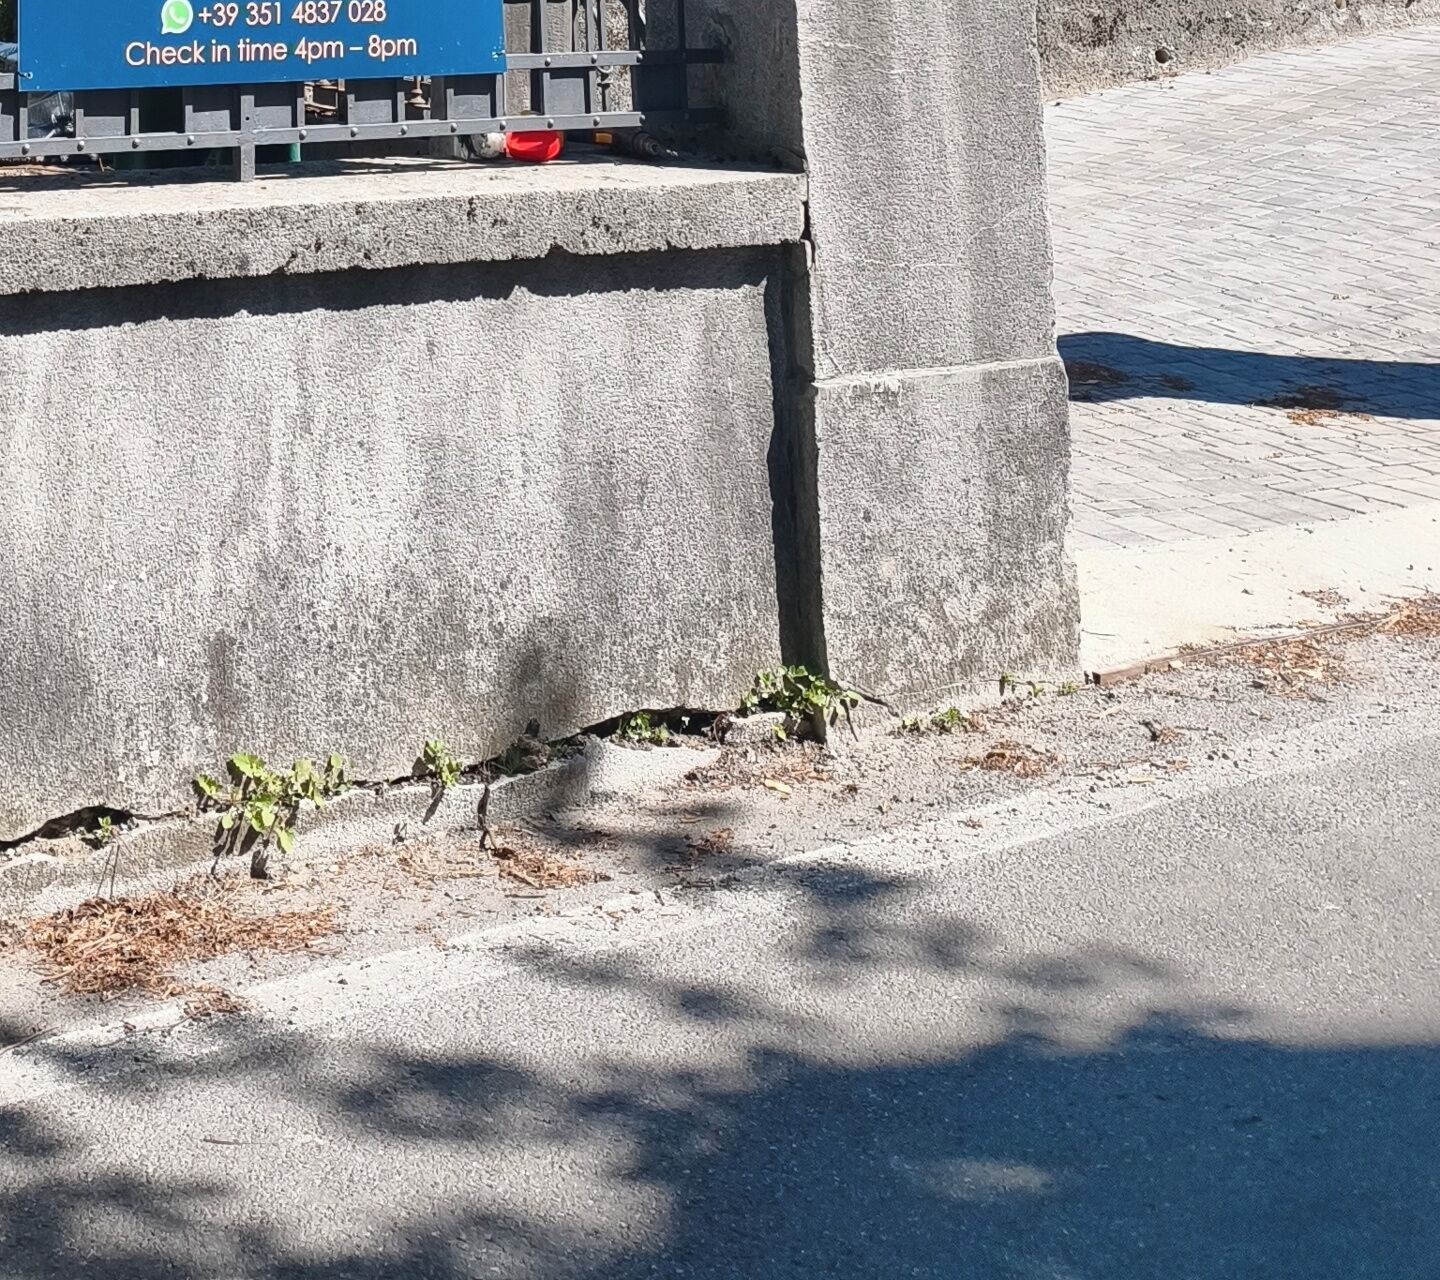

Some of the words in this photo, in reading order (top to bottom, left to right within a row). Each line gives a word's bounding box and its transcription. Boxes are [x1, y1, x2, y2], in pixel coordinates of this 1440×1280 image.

[198, 3, 239, 27] +39
[246, 2, 282, 26] 351
[292, 0, 342, 24] 4837
[348, 0, 387, 23] 028
[126, 41, 205, 67] Check
[211, 40, 231, 63] in
[237, 39, 288, 62] time
[294, 37, 343, 65] 4pm
[368, 34, 417, 62] 8pm
